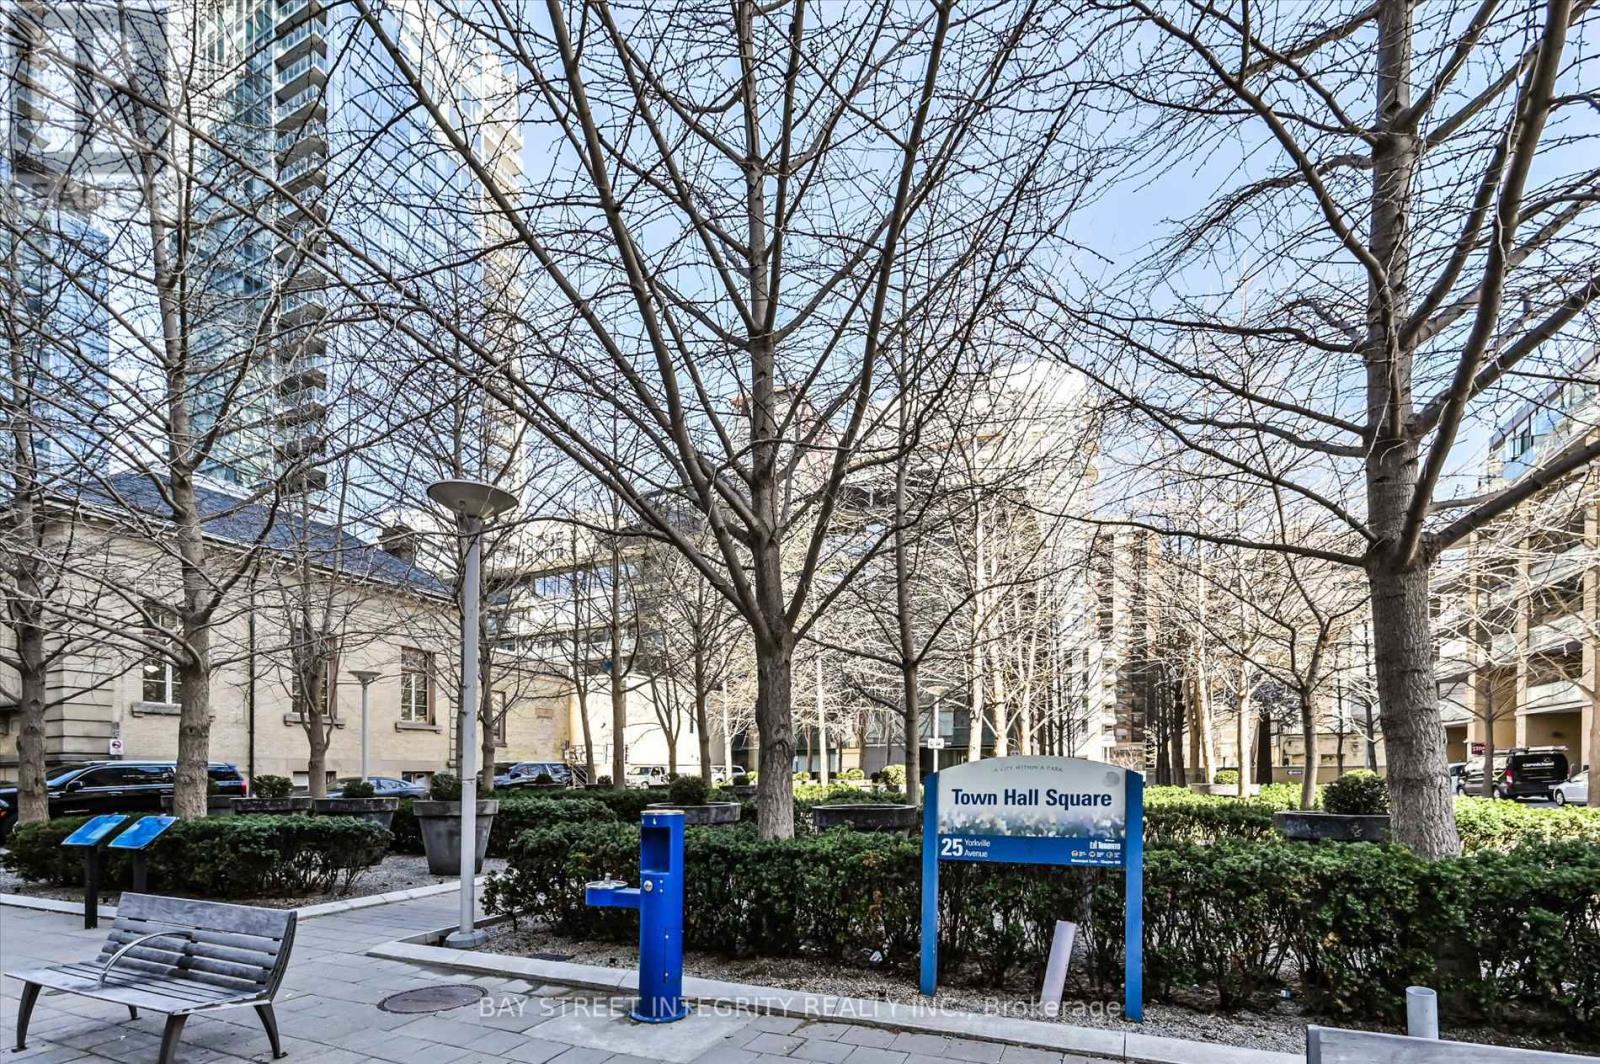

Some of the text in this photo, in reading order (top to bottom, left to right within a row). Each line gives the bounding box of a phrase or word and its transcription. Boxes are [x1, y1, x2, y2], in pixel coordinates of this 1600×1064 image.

[951, 789, 1112, 811] Town Hall Square
[941, 838, 991, 857] 25 Yorkville
[964, 849, 988, 858] Avenue
